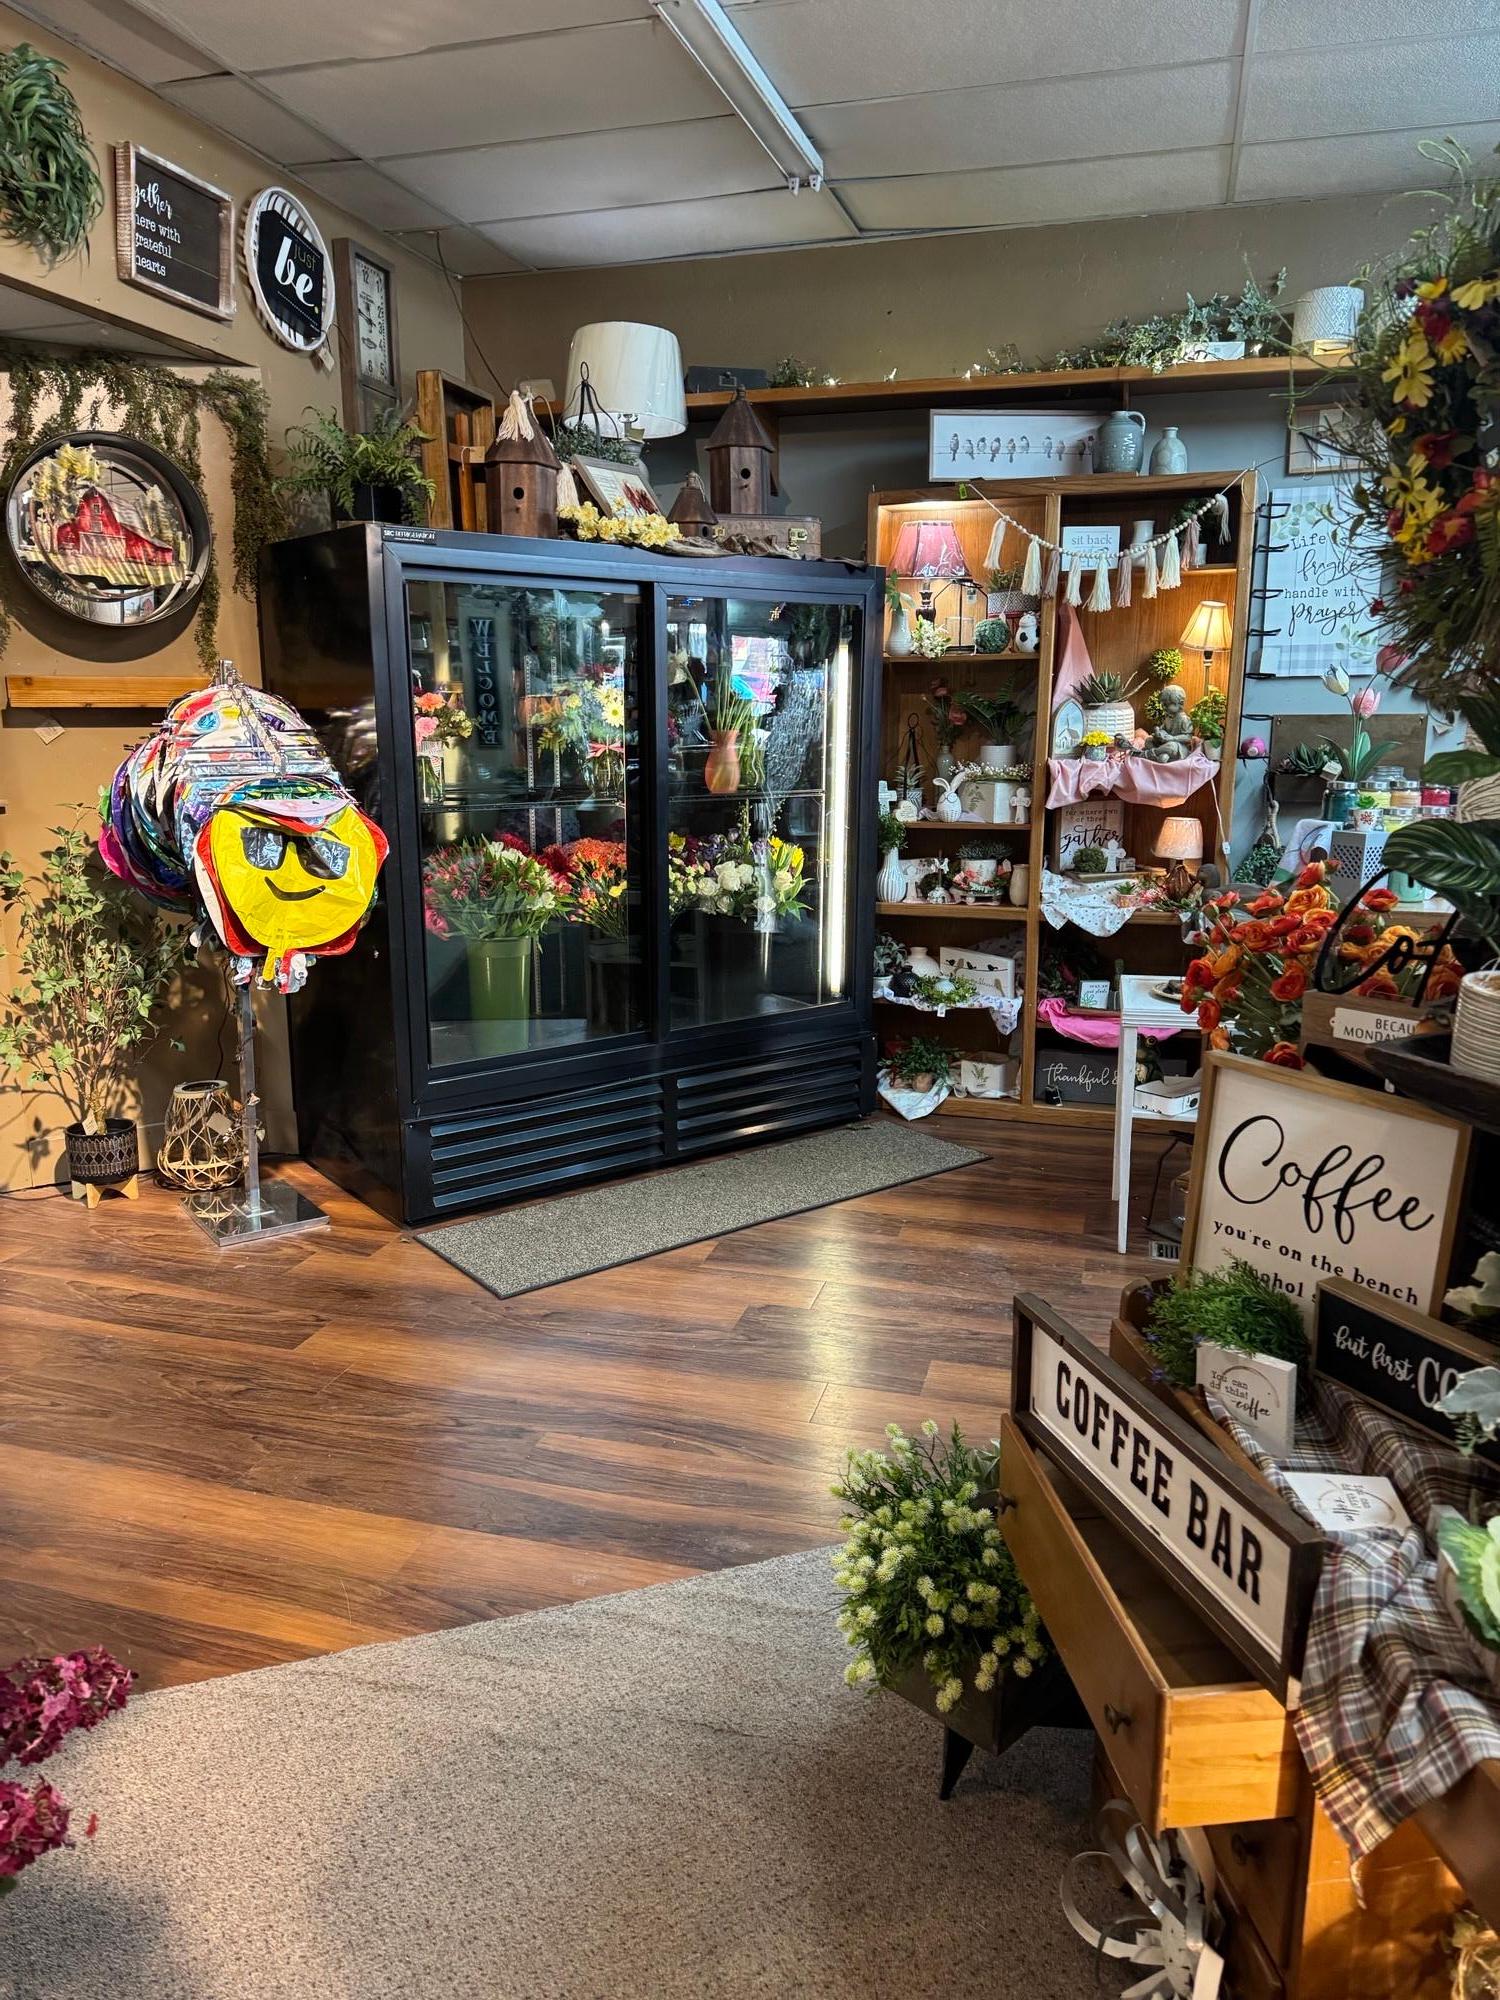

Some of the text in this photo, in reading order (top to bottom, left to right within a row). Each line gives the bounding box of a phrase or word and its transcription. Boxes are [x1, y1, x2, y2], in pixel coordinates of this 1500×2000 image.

[158, 224, 181, 244] with
[1071, 534, 1112, 545] sit back
[1290, 533, 1327, 550] Life
[1284, 586, 1364, 599] handle with
[1288, 600, 1362, 637] prayer
[1060, 823, 1123, 855] gather
[1375, 1018, 1415, 1036] BECAU
[1218, 1115, 1435, 1245] Coffee
[1214, 1220, 1419, 1306] you're on the bench
[1333, 1325, 1370, 1359] but
[1056, 1360, 1264, 1606] COFFEE BAR
